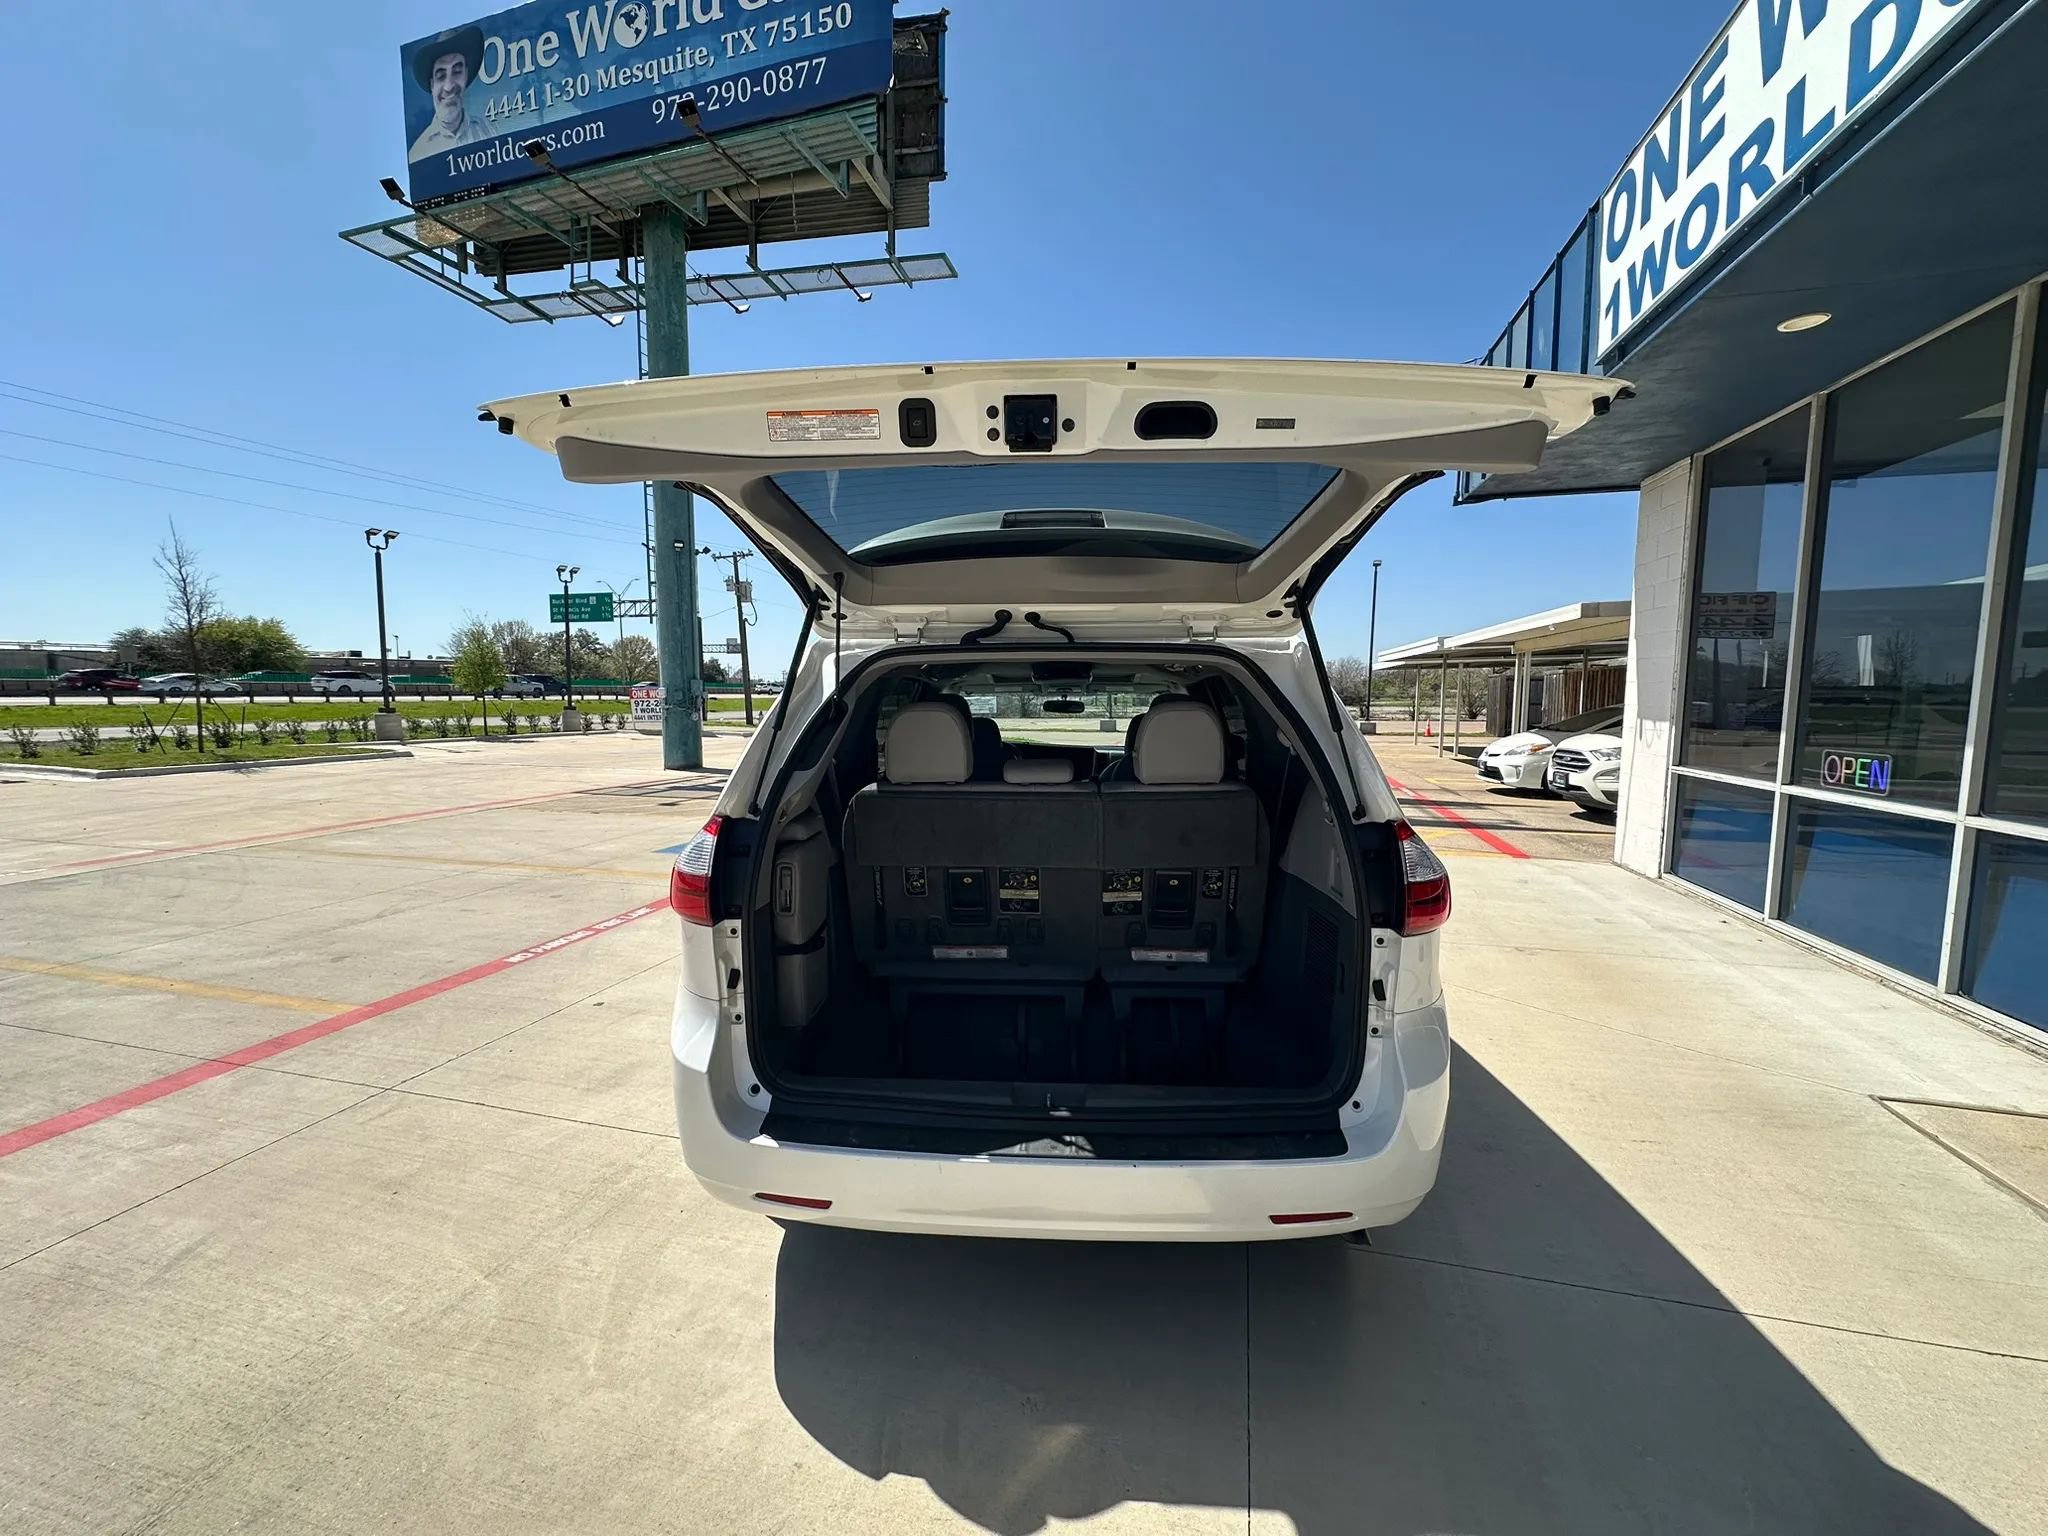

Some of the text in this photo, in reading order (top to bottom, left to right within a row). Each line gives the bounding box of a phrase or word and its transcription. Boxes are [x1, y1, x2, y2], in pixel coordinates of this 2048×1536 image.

[478, 31, 560, 85] One
[485, 2, 852, 122] 4441 I-30 Mesquite, TX 75150
[446, 121, 605, 176] 1worldcs.com
[1604, 0, 1940, 341] 1WORLD
[1606, 34, 1729, 263] ONE
[632, 690, 648, 698] ONE
[1823, 755, 1889, 791] OPEN
